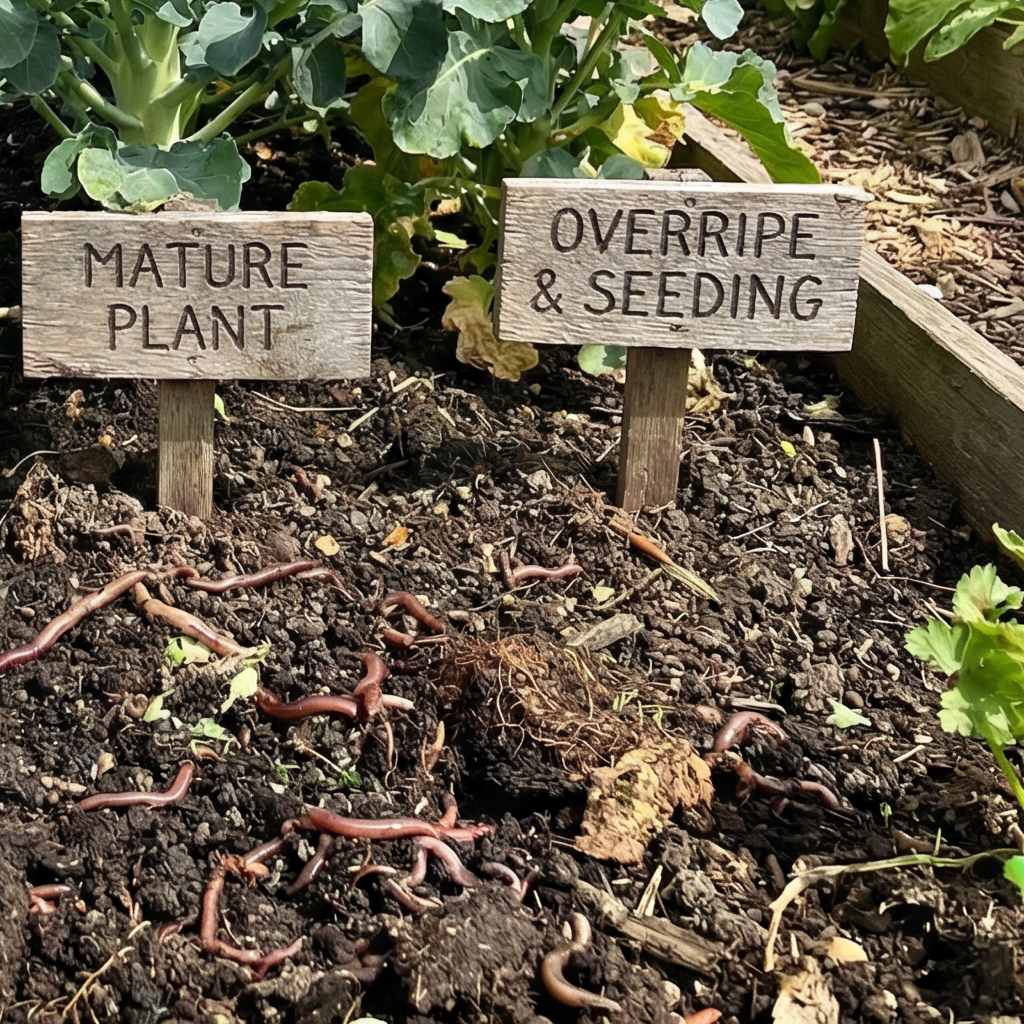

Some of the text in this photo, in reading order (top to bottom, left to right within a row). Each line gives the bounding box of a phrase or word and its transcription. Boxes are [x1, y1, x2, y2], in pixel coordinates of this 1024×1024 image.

[550, 207, 820, 260] OVERRIPE
[83, 242, 308, 289] MATURE
[529, 268, 823, 321] & SEEDING
[107, 304, 285, 351] PLANT
